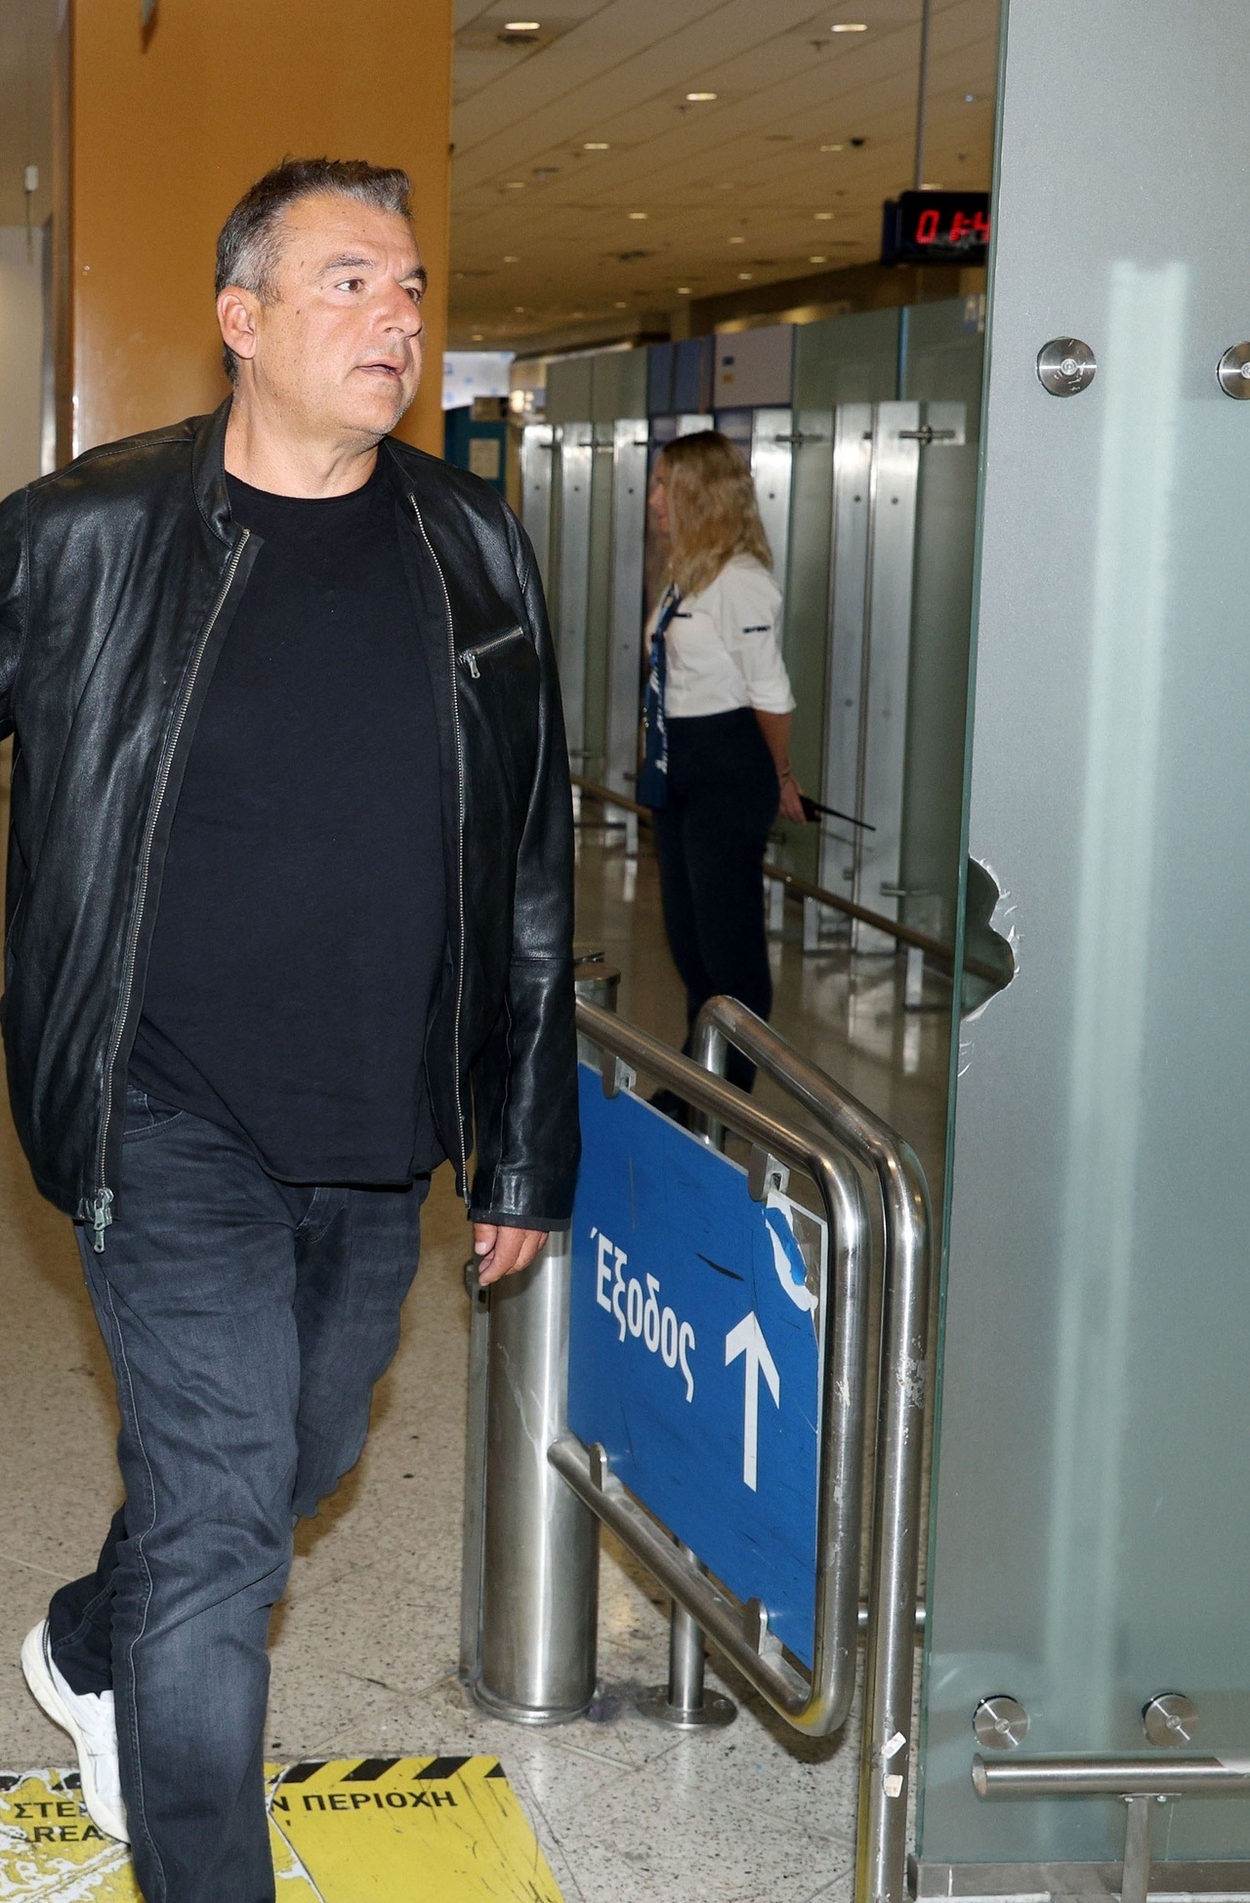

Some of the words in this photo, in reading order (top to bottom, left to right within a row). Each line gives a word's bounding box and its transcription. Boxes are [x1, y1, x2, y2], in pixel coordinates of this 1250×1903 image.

[915, 209, 992, 244] 01:4
[590, 1226, 696, 1403] Έξοδος
[302, 1790, 458, 1811] ΠΕΡΙΟΧΗ
